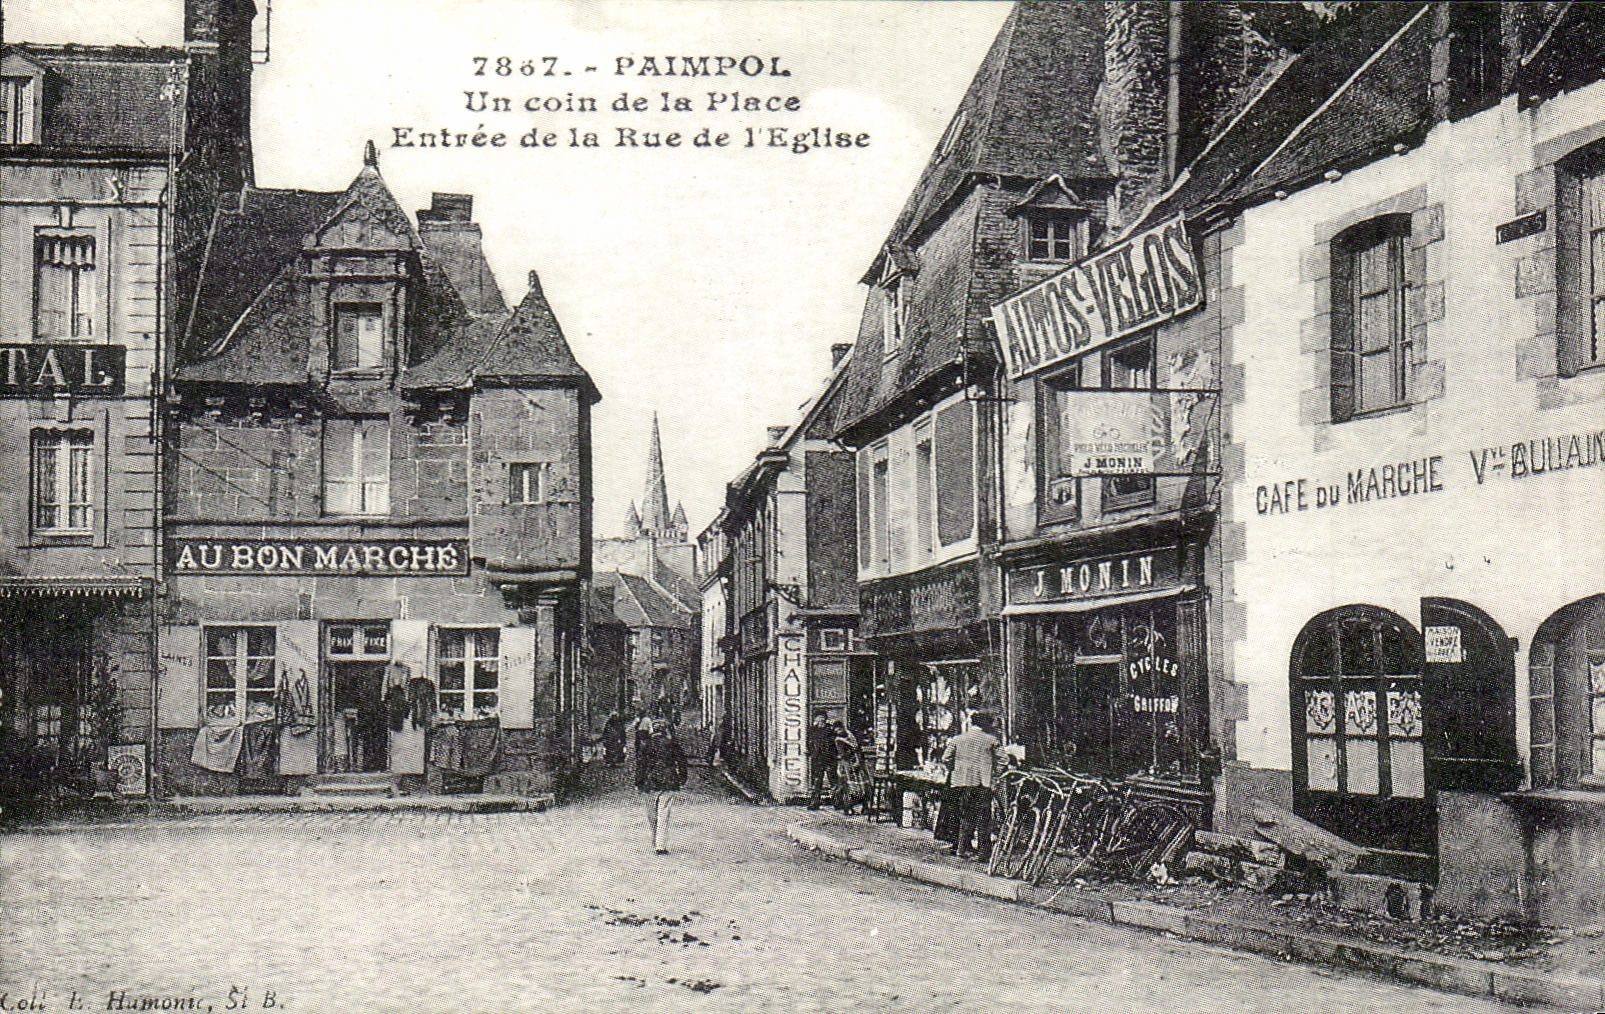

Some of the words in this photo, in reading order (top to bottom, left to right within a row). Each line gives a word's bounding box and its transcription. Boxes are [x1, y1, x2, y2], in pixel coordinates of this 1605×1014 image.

[1095, 456, 1143, 468] MONIN
[1256, 479, 1308, 515] CAFE
[1316, 485, 1340, 508] DU
[1347, 456, 1443, 503] MARCHE
[176, 544, 222, 569] AU
[231, 545, 301, 570] BON
[313, 543, 458, 570] MARCHÉ
[1060, 556, 1154, 595] MONIN
[1129, 656, 1178, 680] CYCLES
